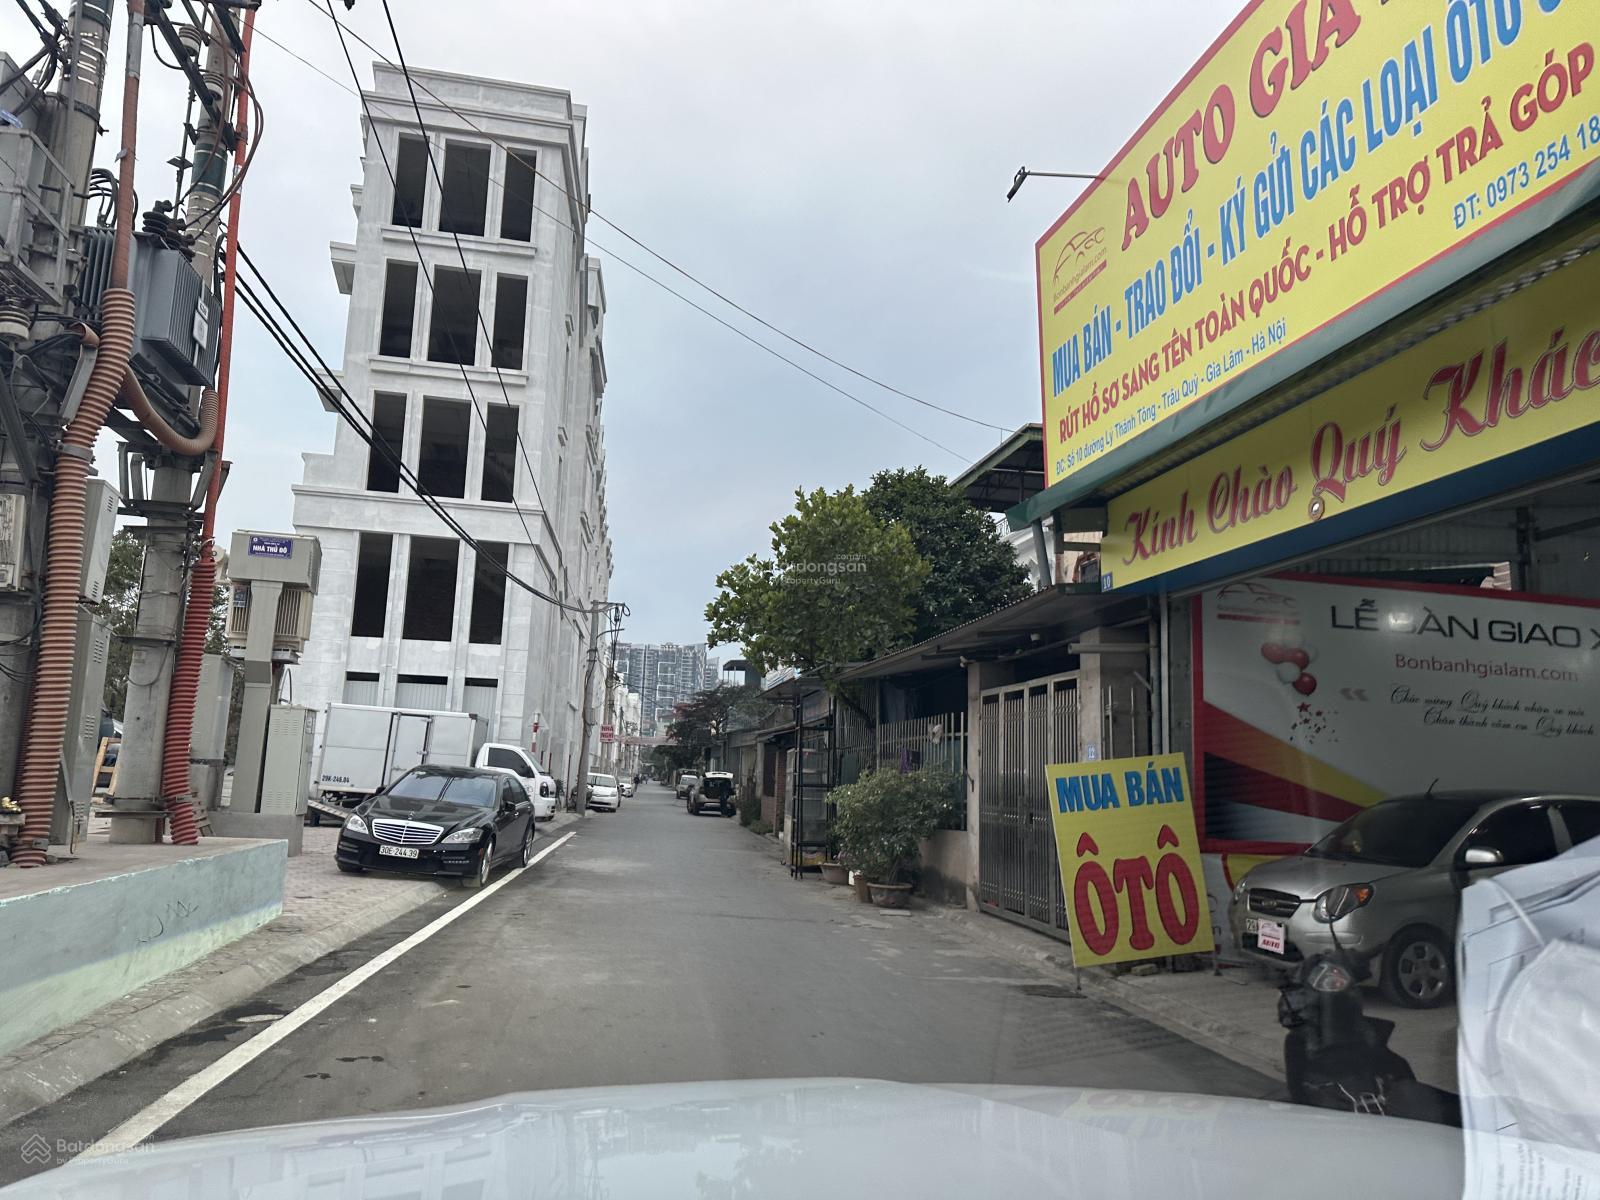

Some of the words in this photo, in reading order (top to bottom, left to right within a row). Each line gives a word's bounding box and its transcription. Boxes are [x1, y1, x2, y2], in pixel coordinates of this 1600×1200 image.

[1122, 84, 1236, 251] AUTO
[1250, 0, 1361, 118] GIA
[1453, 193, 1482, 229] ĐT:
[1486, 161, 1530, 208] 0973
[1535, 134, 1571, 180] 254
[1052, 335, 1080, 397] MUA
[1083, 304, 1112, 374] BÁN
[1125, 260, 1166, 339] TRAO
[1170, 209, 1202, 305] ĐỔI
[1219, 176, 1246, 265] KÝ
[1253, 131, 1294, 238] GỬI
[1300, 100, 1356, 200] CÁC
[1362, 25, 1438, 153] LOẠI
[1059, 406, 1079, 444] RÚT
[1082, 382, 1100, 428] HỒ
[1102, 378, 1119, 414] SƠ
[1122, 352, 1160, 401] SANG
[1162, 328, 1192, 373] TÊN
[1195, 290, 1245, 350] TOÀN
[1250, 237, 1311, 318] QUỐC
[1329, 184, 1367, 262] HỖ
[1372, 155, 1430, 229] TRỢ
[1436, 96, 1504, 184] TRẢ
[1510, 42, 1594, 132] GÓP
[1206, 361, 1221, 382] Gia
[1223, 348, 1244, 372] Lâm
[1268, 317, 1286, 345] Nội
[1122, 487, 1198, 566] Kính
[1207, 464, 1298, 534] Chào
[1311, 402, 1407, 503] Quý
[1330, 598, 1380, 631] LỄ
[1488, 620, 1582, 649] GIAO
[1395, 653, 1579, 682] Bonbanhgialam.com
[1055, 773, 1121, 813] MUA
[1124, 762, 1184, 807] BÁN
[1074, 824, 1199, 956] ÔTÔ
